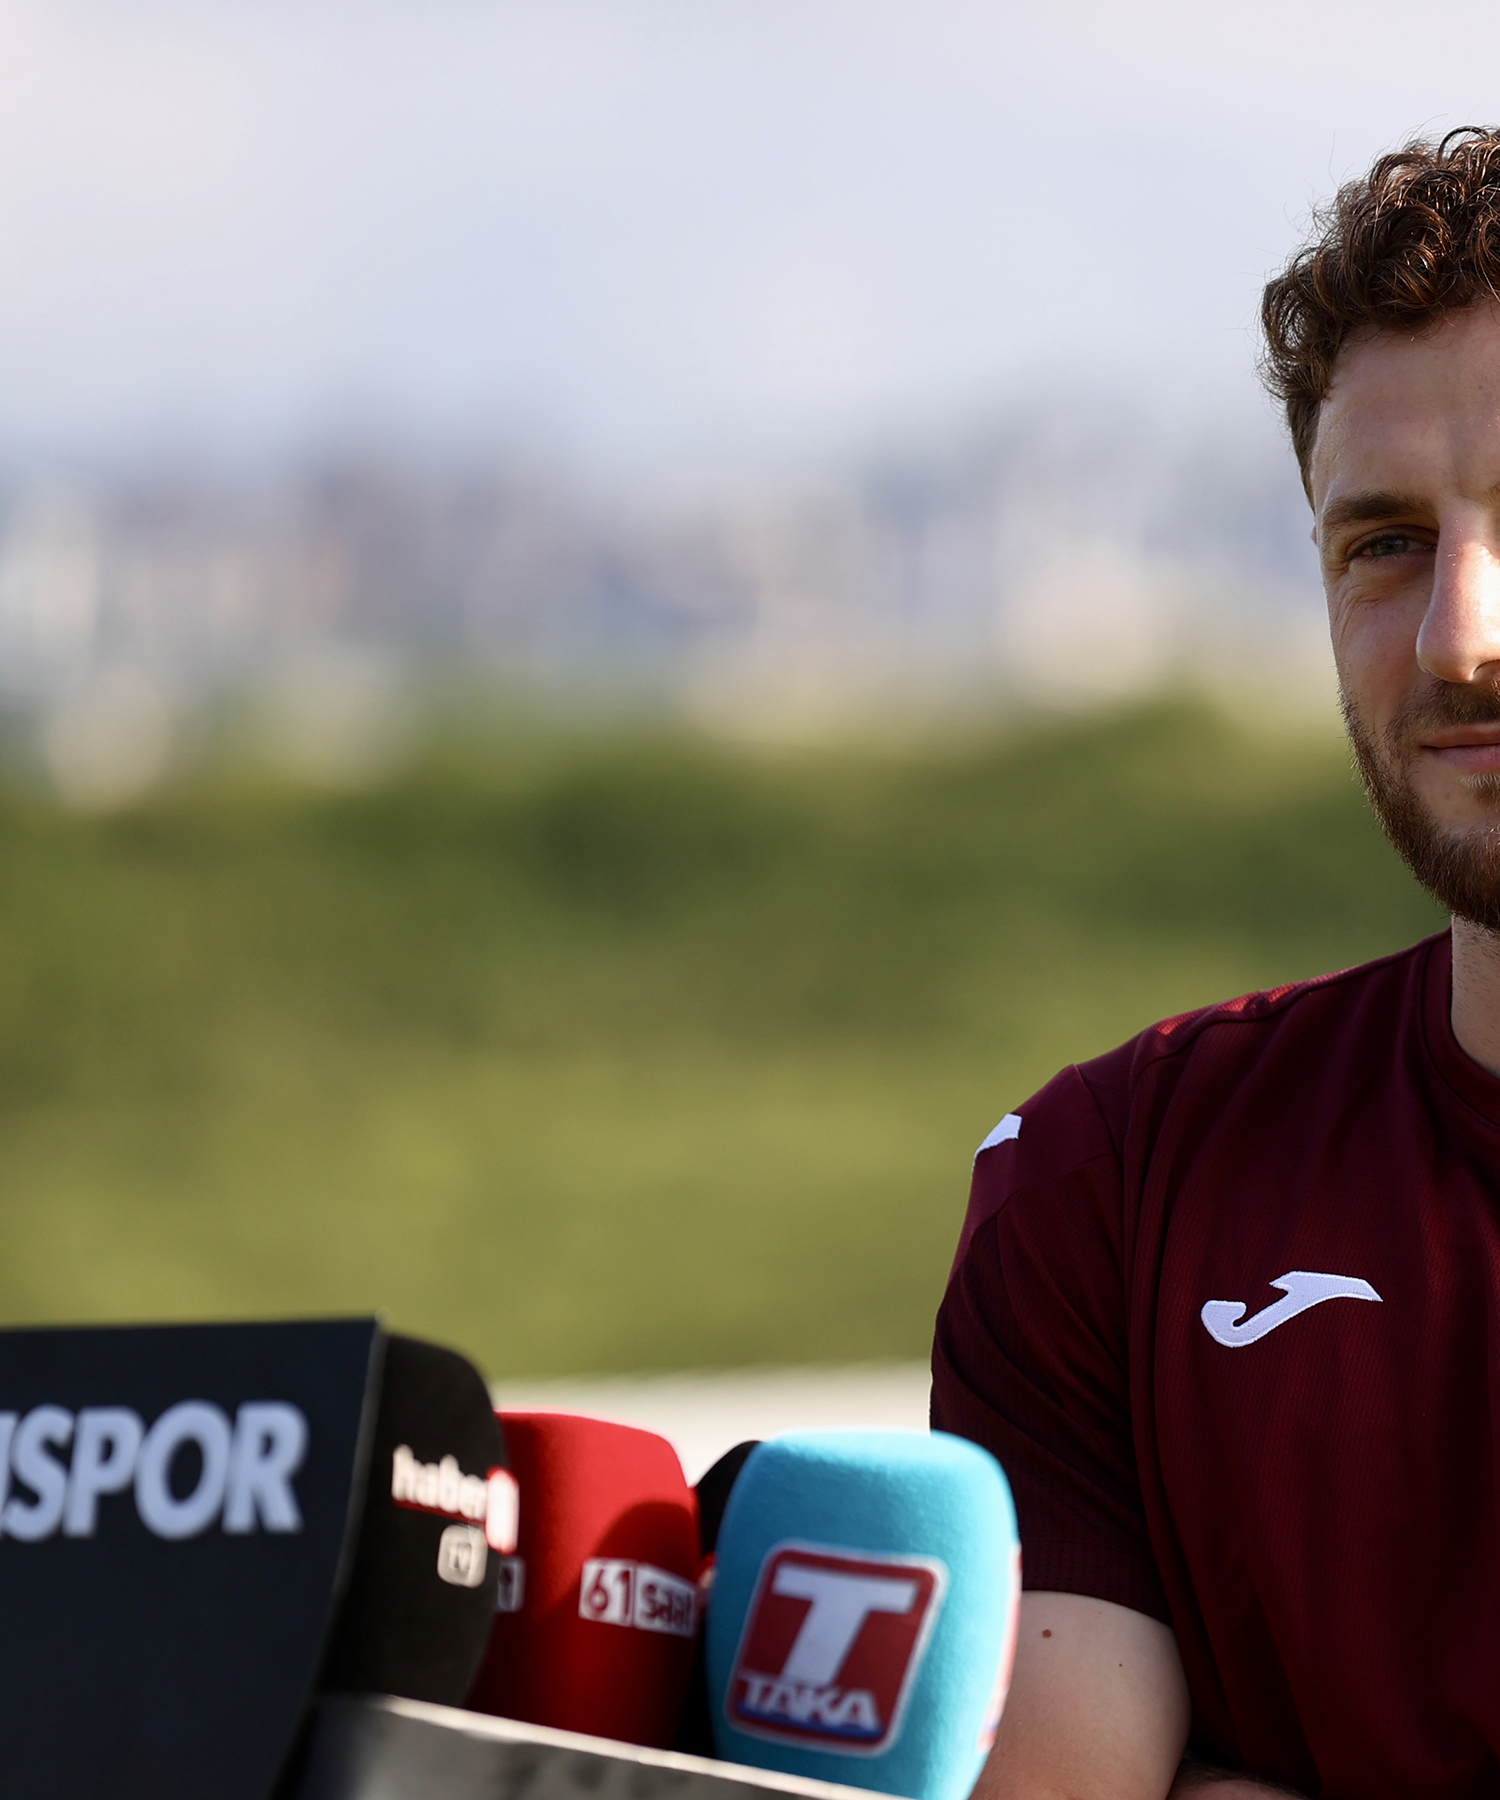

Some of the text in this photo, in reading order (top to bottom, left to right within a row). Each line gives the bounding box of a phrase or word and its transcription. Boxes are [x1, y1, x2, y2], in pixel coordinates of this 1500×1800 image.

[0, 1400, 307, 1541] SPOR
[588, 1566, 632, 1615] 61
[772, 1564, 917, 1685] T
[739, 1672, 877, 1730] TAKA
